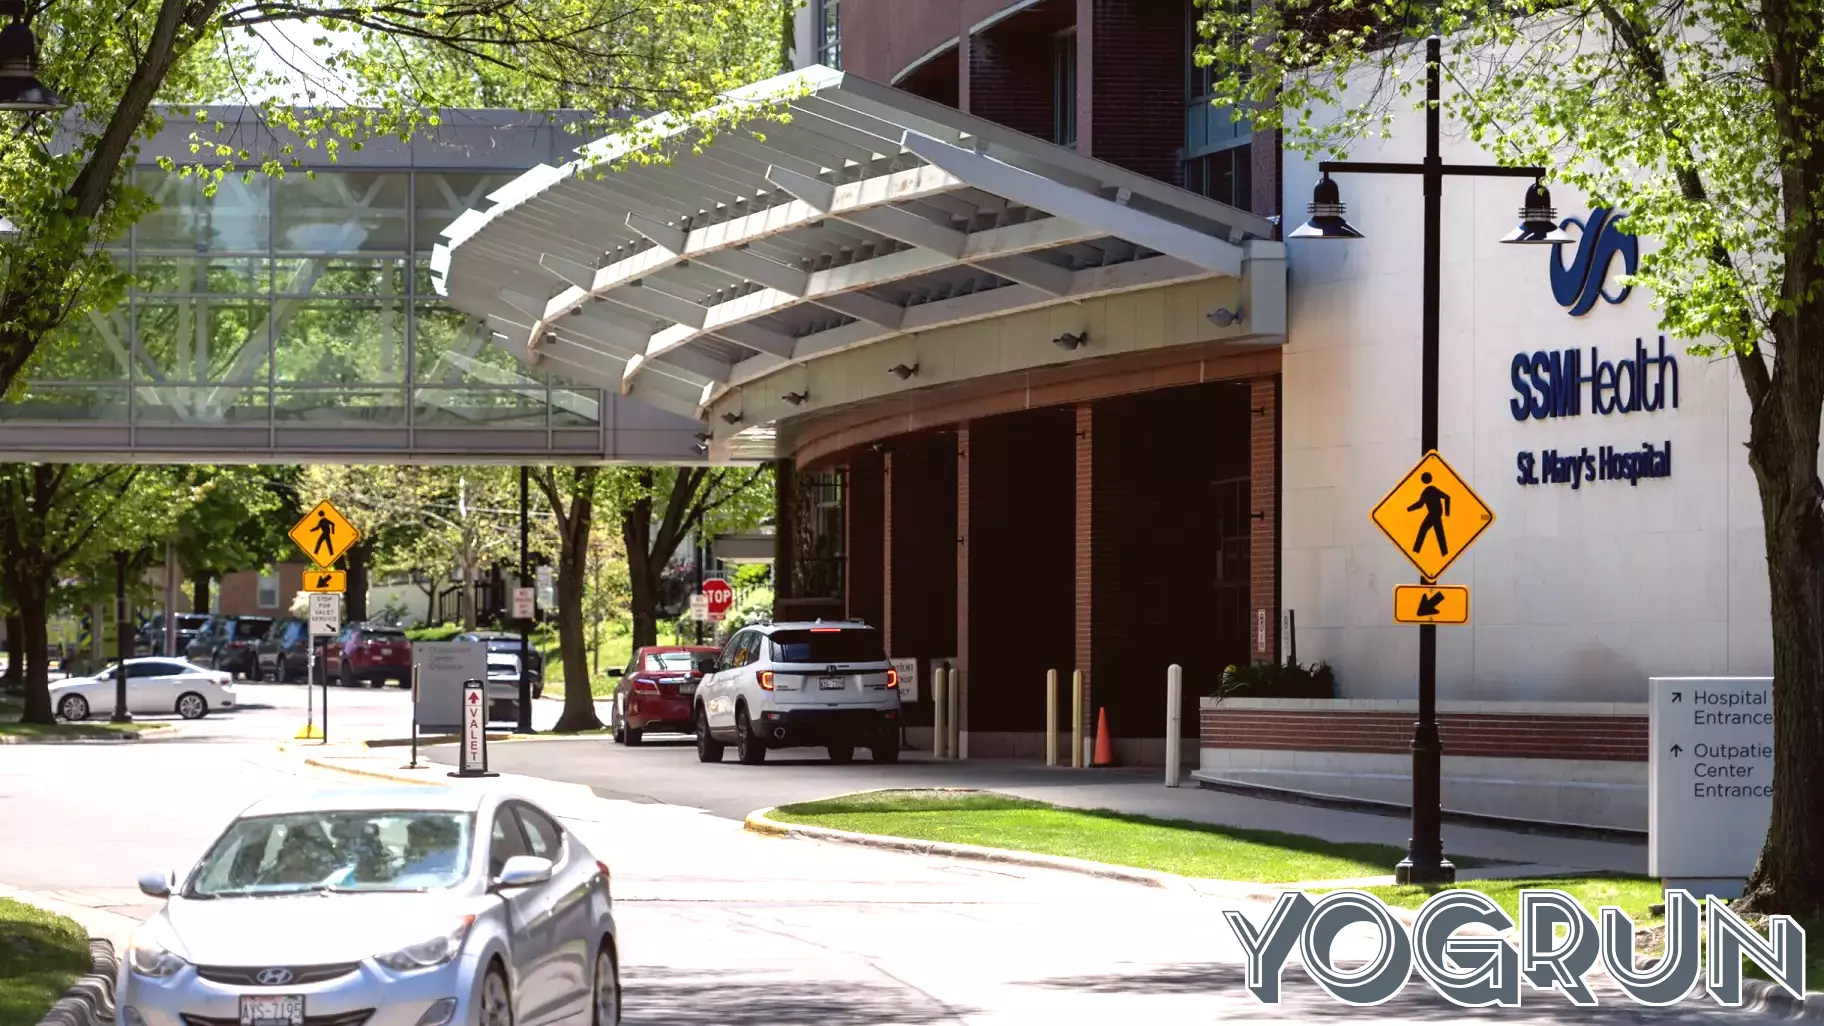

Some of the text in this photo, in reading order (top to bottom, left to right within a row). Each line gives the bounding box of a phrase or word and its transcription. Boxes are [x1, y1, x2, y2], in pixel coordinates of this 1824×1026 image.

[1516, 440, 1672, 490] St. Mary's Hospital
[1694, 690, 1767, 708] Hospital
[1694, 710, 1774, 725] Entrance
[469, 708, 479, 762] VALET
[1694, 743, 1773, 760] Outpatie
[1694, 762, 1754, 778] Center
[1694, 783, 1774, 798] Entrance
[242, 1003, 301, 1020] AYS-7195
